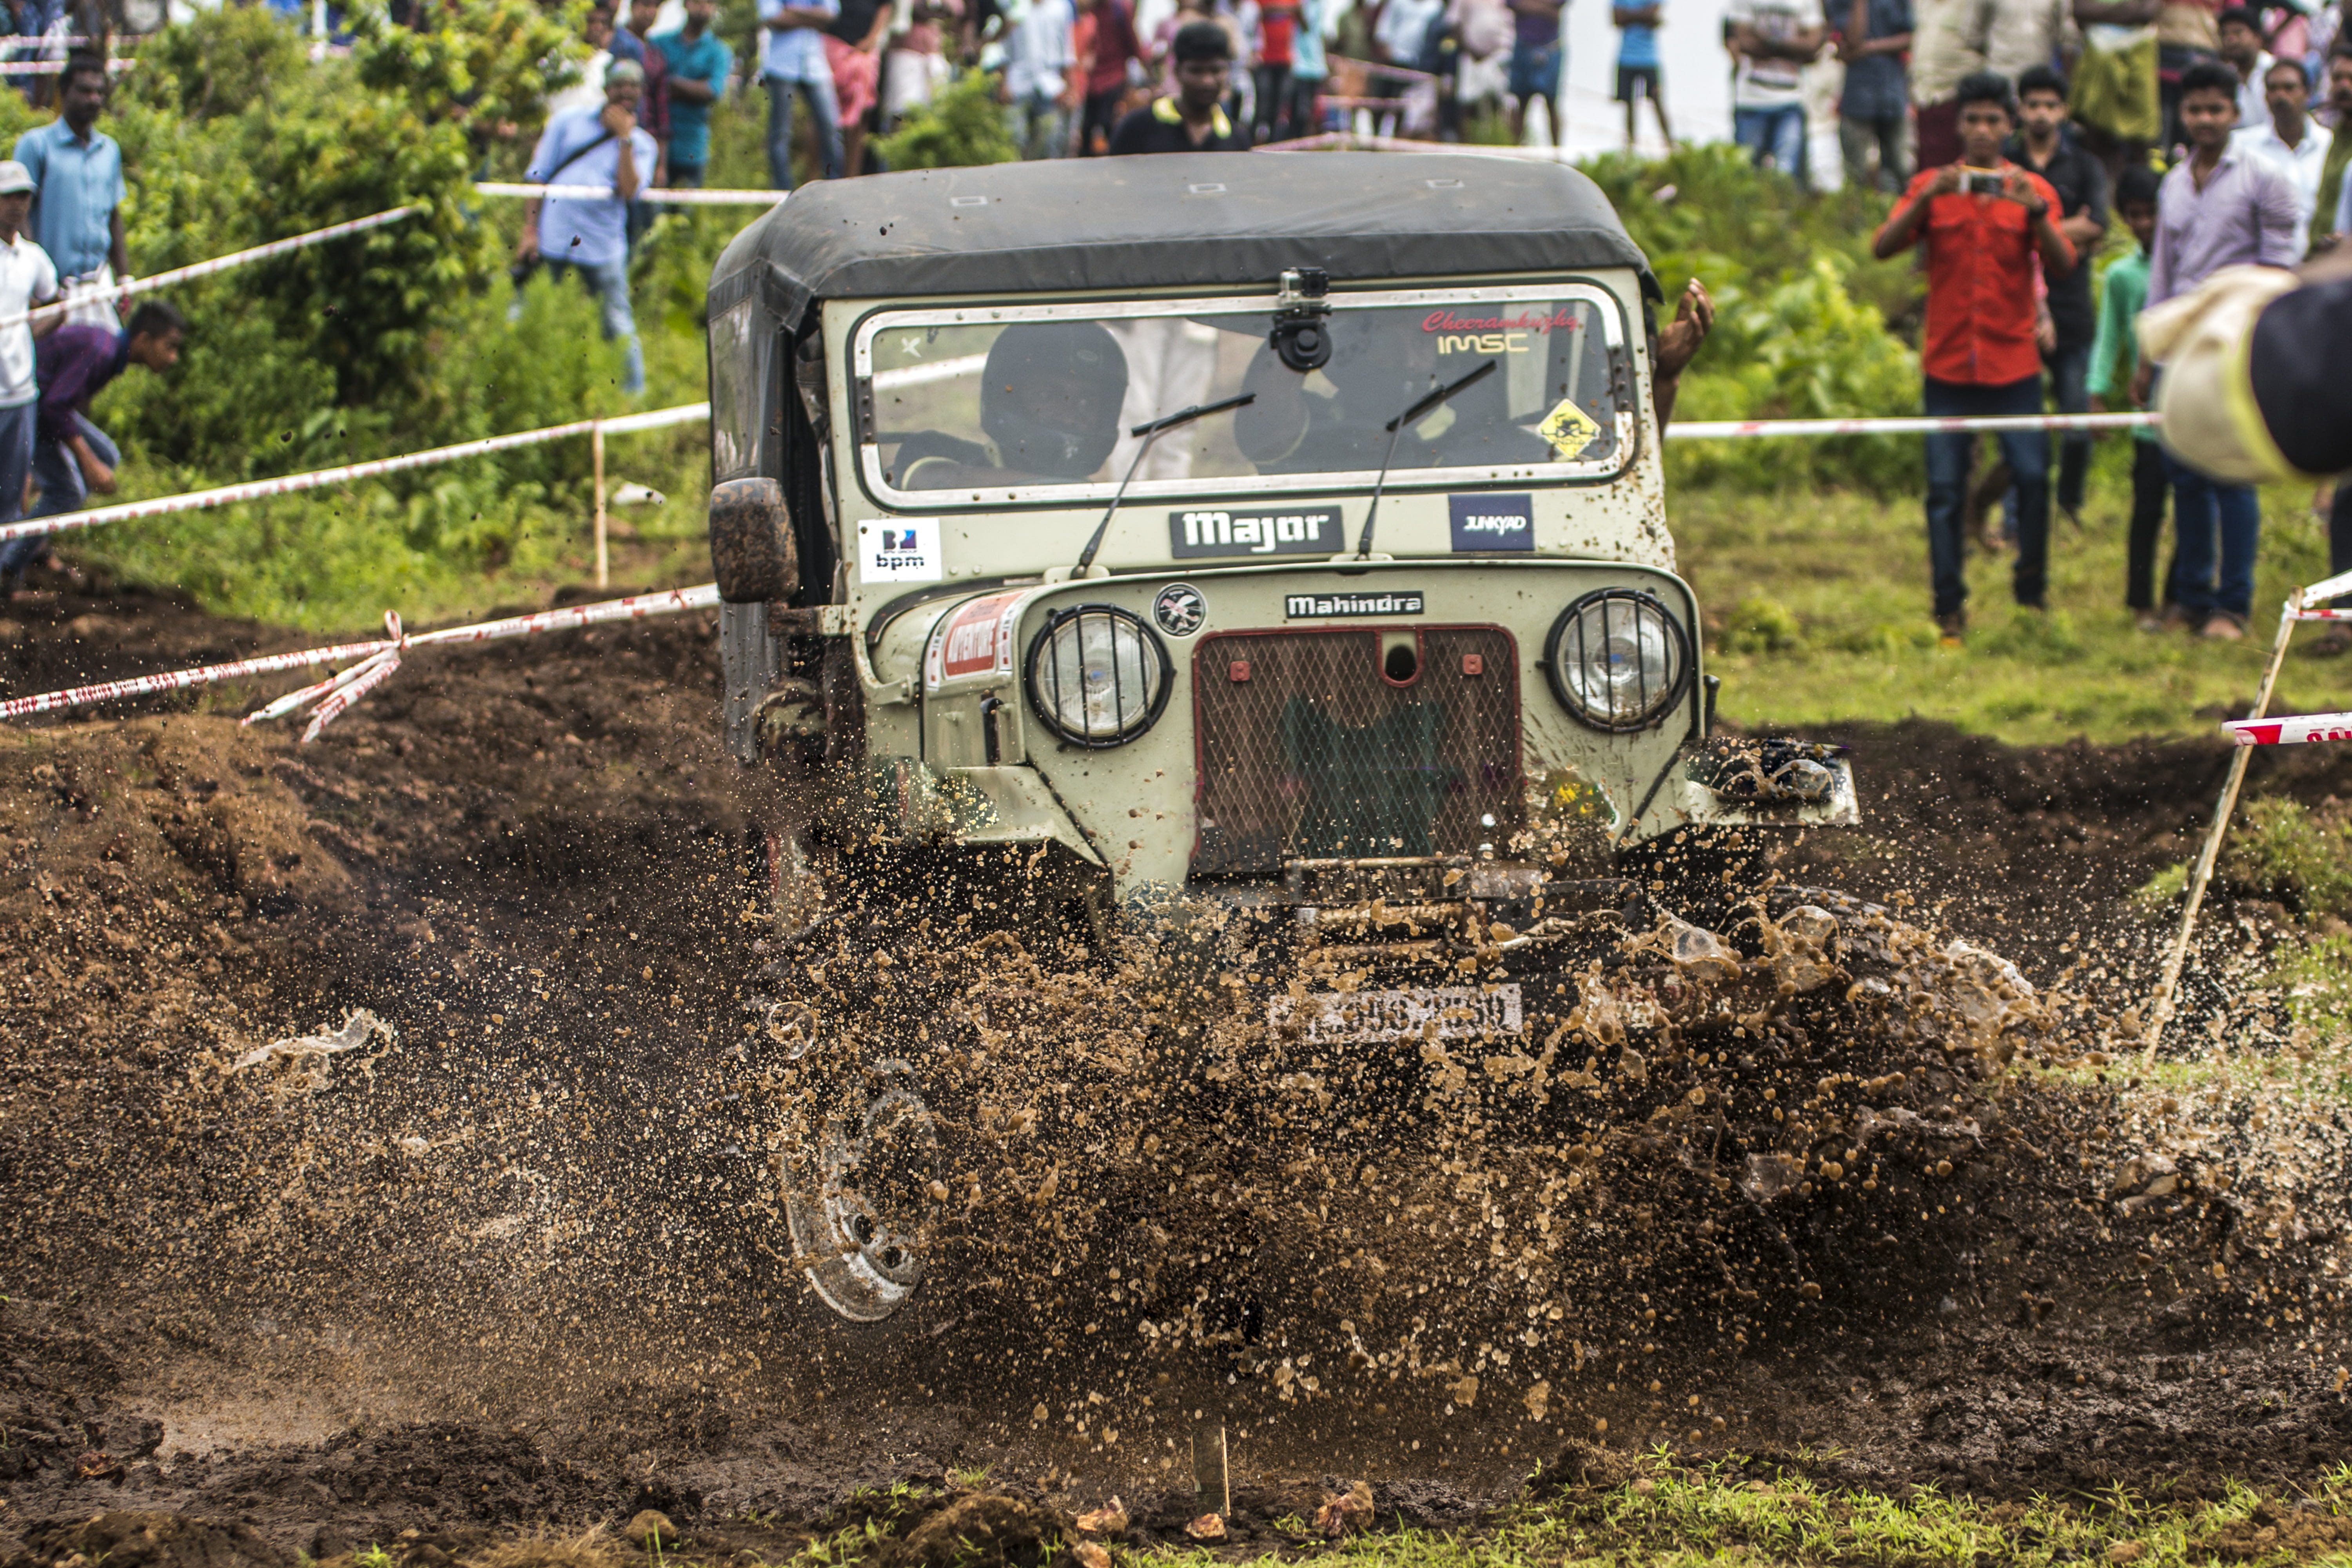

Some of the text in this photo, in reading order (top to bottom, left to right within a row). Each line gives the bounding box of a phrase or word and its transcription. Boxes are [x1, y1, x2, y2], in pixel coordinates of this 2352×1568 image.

[1437, 333, 1529, 354] IMSC
[1181, 511, 1329, 553] Major
[876, 554, 924, 571] bpm
[1287, 594, 1422, 615] Mahindra
